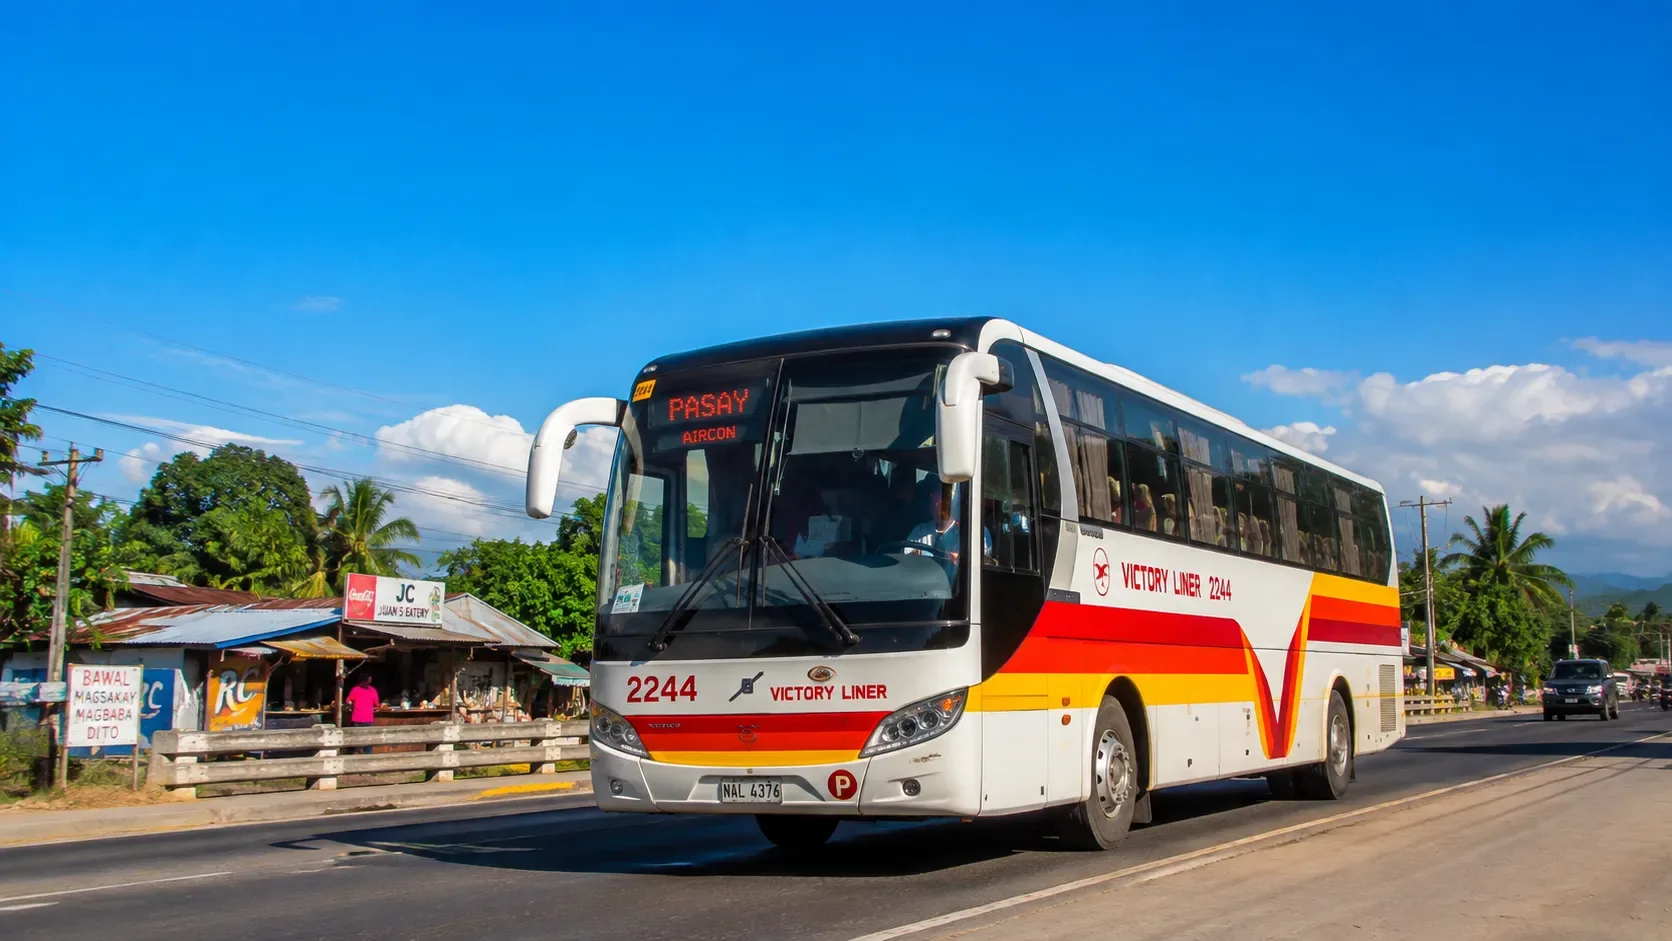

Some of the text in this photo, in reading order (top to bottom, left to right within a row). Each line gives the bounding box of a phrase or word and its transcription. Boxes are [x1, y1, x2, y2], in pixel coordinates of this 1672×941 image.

[669, 388, 749, 421] PASAY
[683, 426, 736, 443] AIRCON
[1121, 562, 1232, 601] VICTORY LINER 2244
[396, 584, 415, 603] JC
[405, 607, 430, 618] EATERY
[82, 669, 130, 687] BAWAL
[215, 668, 260, 715] RC
[627, 675, 697, 703] 2244
[770, 684, 887, 701] VICTORY LINER
[74, 691, 137, 705] MAGSAKAY
[76, 708, 132, 723] MAGBABA
[87, 726, 119, 740] DITO
[723, 783, 780, 798] NAL 4376
[835, 775, 850, 796] P
